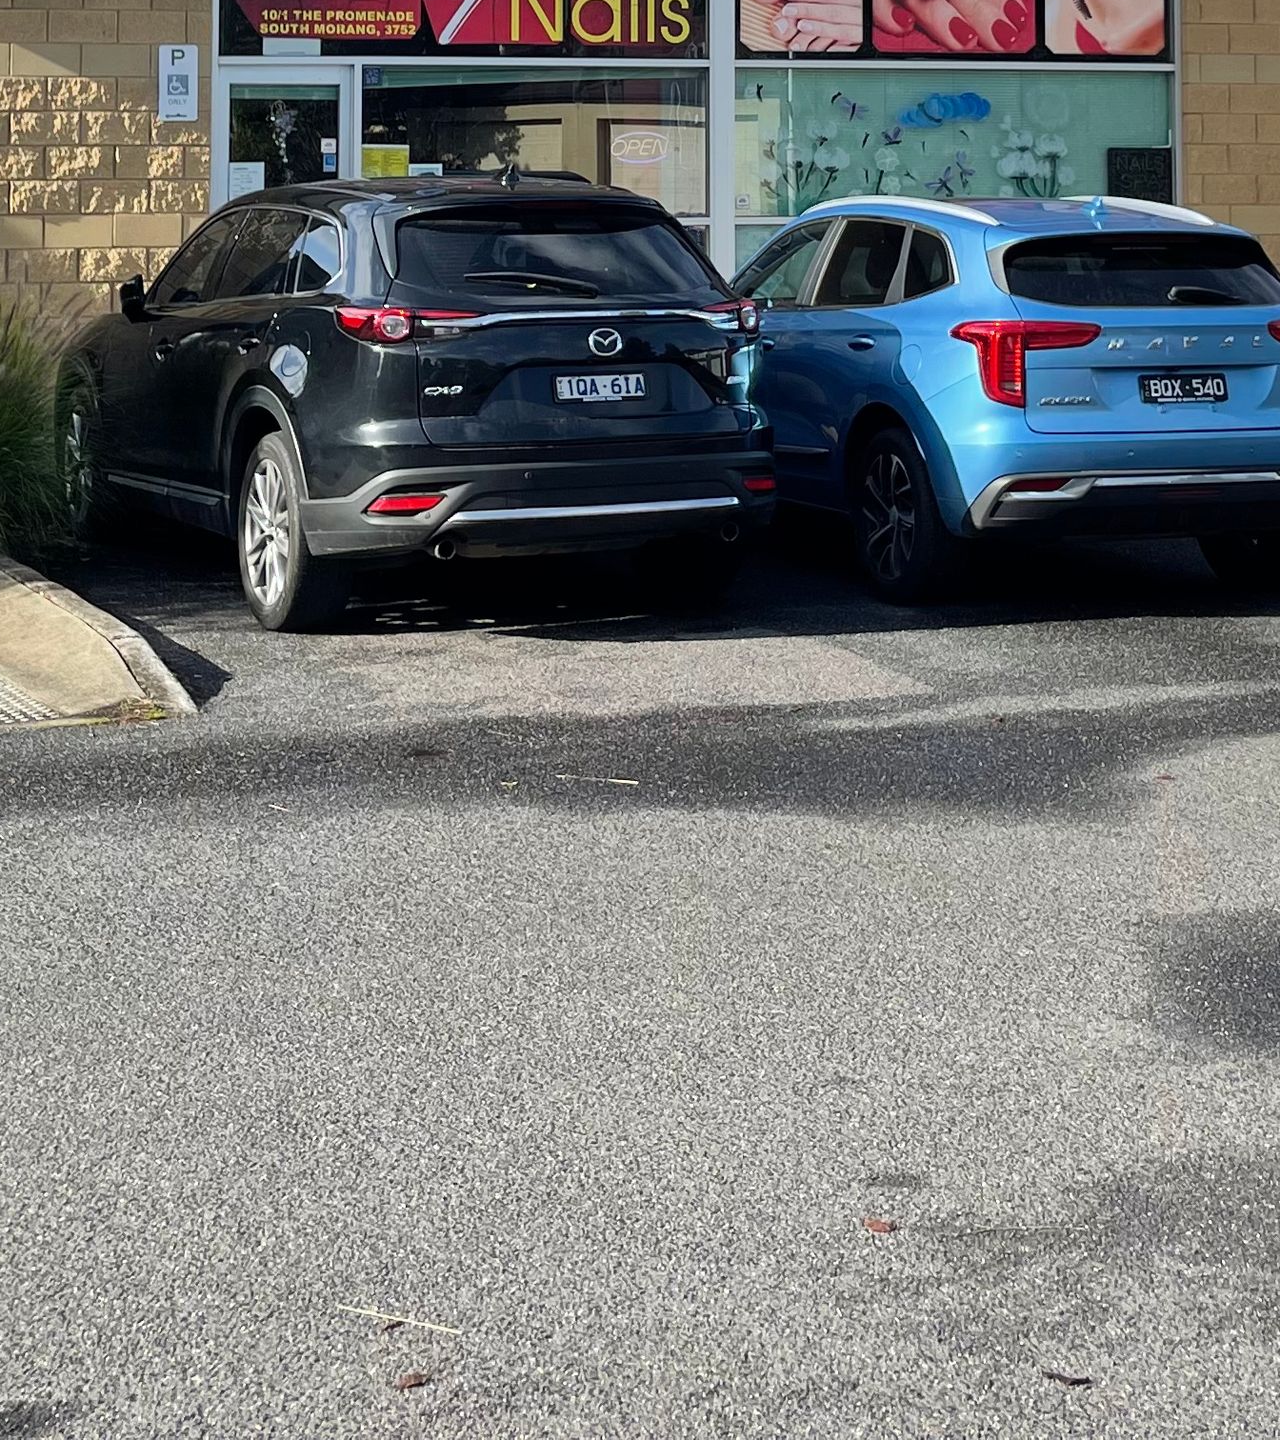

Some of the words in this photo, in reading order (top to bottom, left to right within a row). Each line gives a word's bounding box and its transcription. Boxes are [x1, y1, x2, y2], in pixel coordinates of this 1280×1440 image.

[261, 10, 288, 21] 10/1
[293, 10, 321, 22] THE
[326, 10, 414, 22] PROMENADE
[259, 23, 309, 35] SOUTH
[313, 23, 380, 37] MORANG,
[385, 24, 416, 35] 3752
[171, 49, 185, 66] P
[167, 98, 188, 106] ONLY
[611, 138, 669, 156] OPEN
